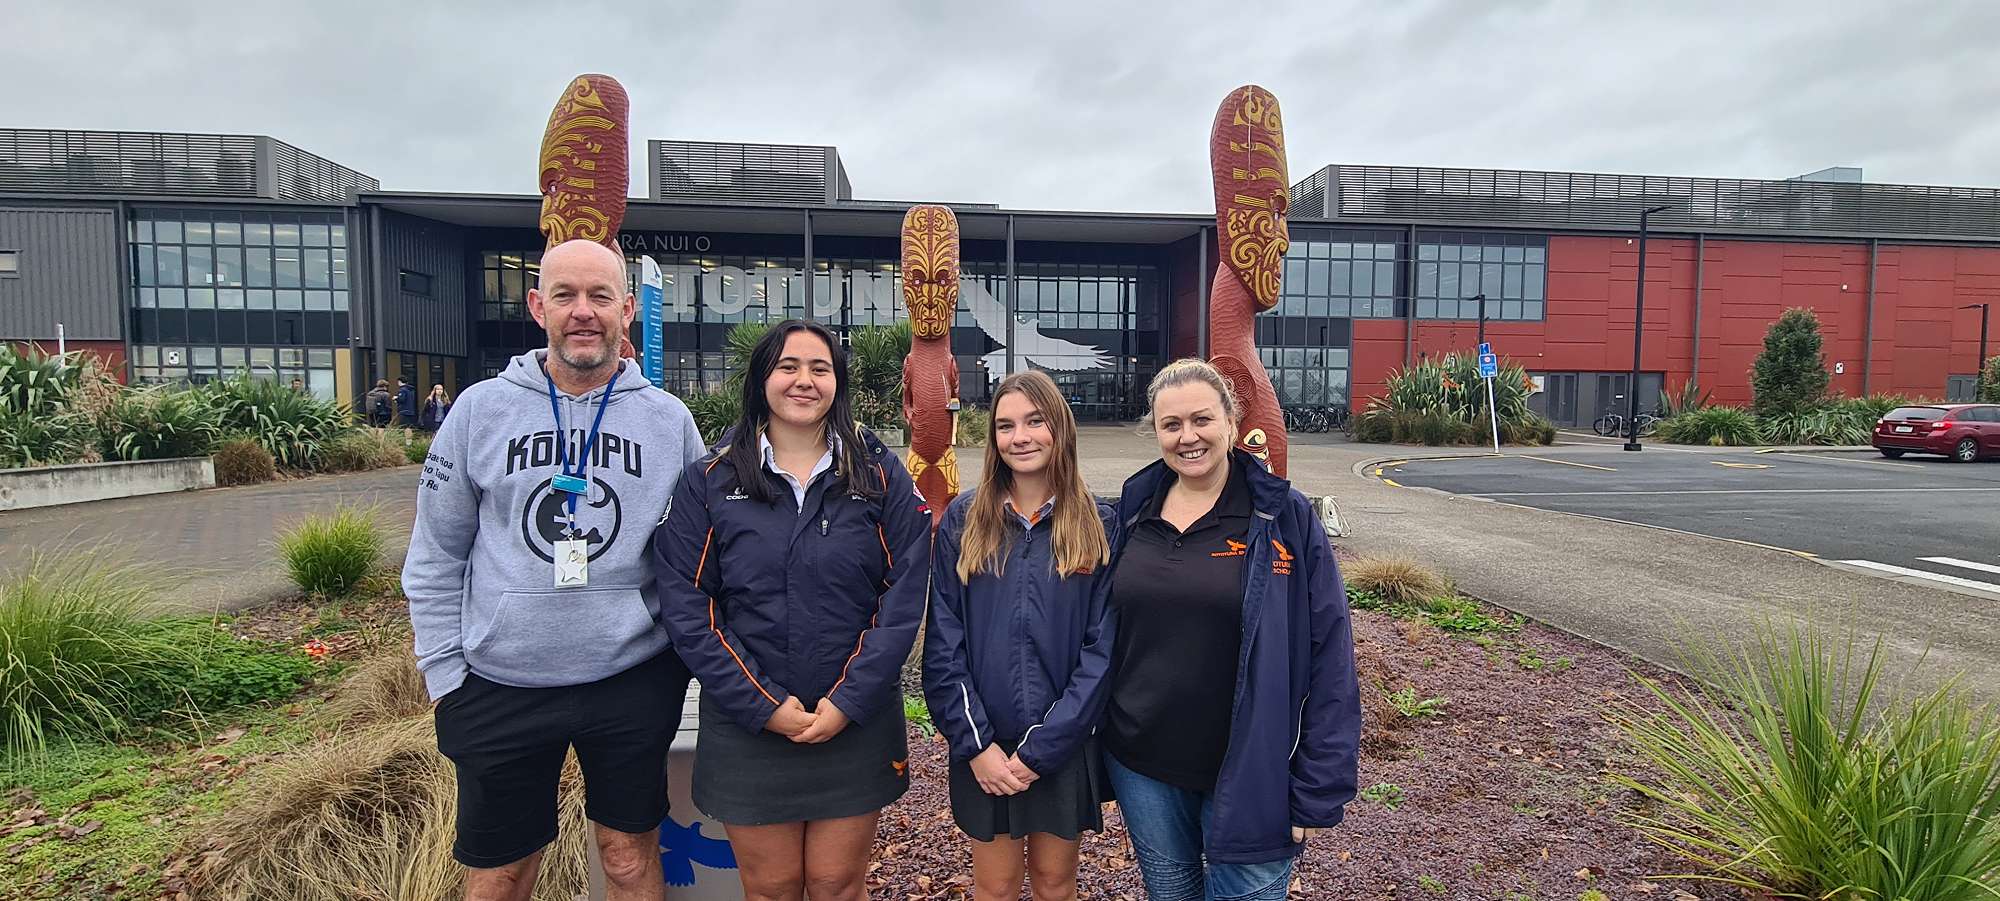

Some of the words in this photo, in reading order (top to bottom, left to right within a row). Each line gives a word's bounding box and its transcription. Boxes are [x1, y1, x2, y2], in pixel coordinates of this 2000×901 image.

[619, 233, 648, 250] RA
[654, 235, 689, 251] NUI
[695, 236, 711, 252] O
[630, 264, 906, 319] TOTUN
